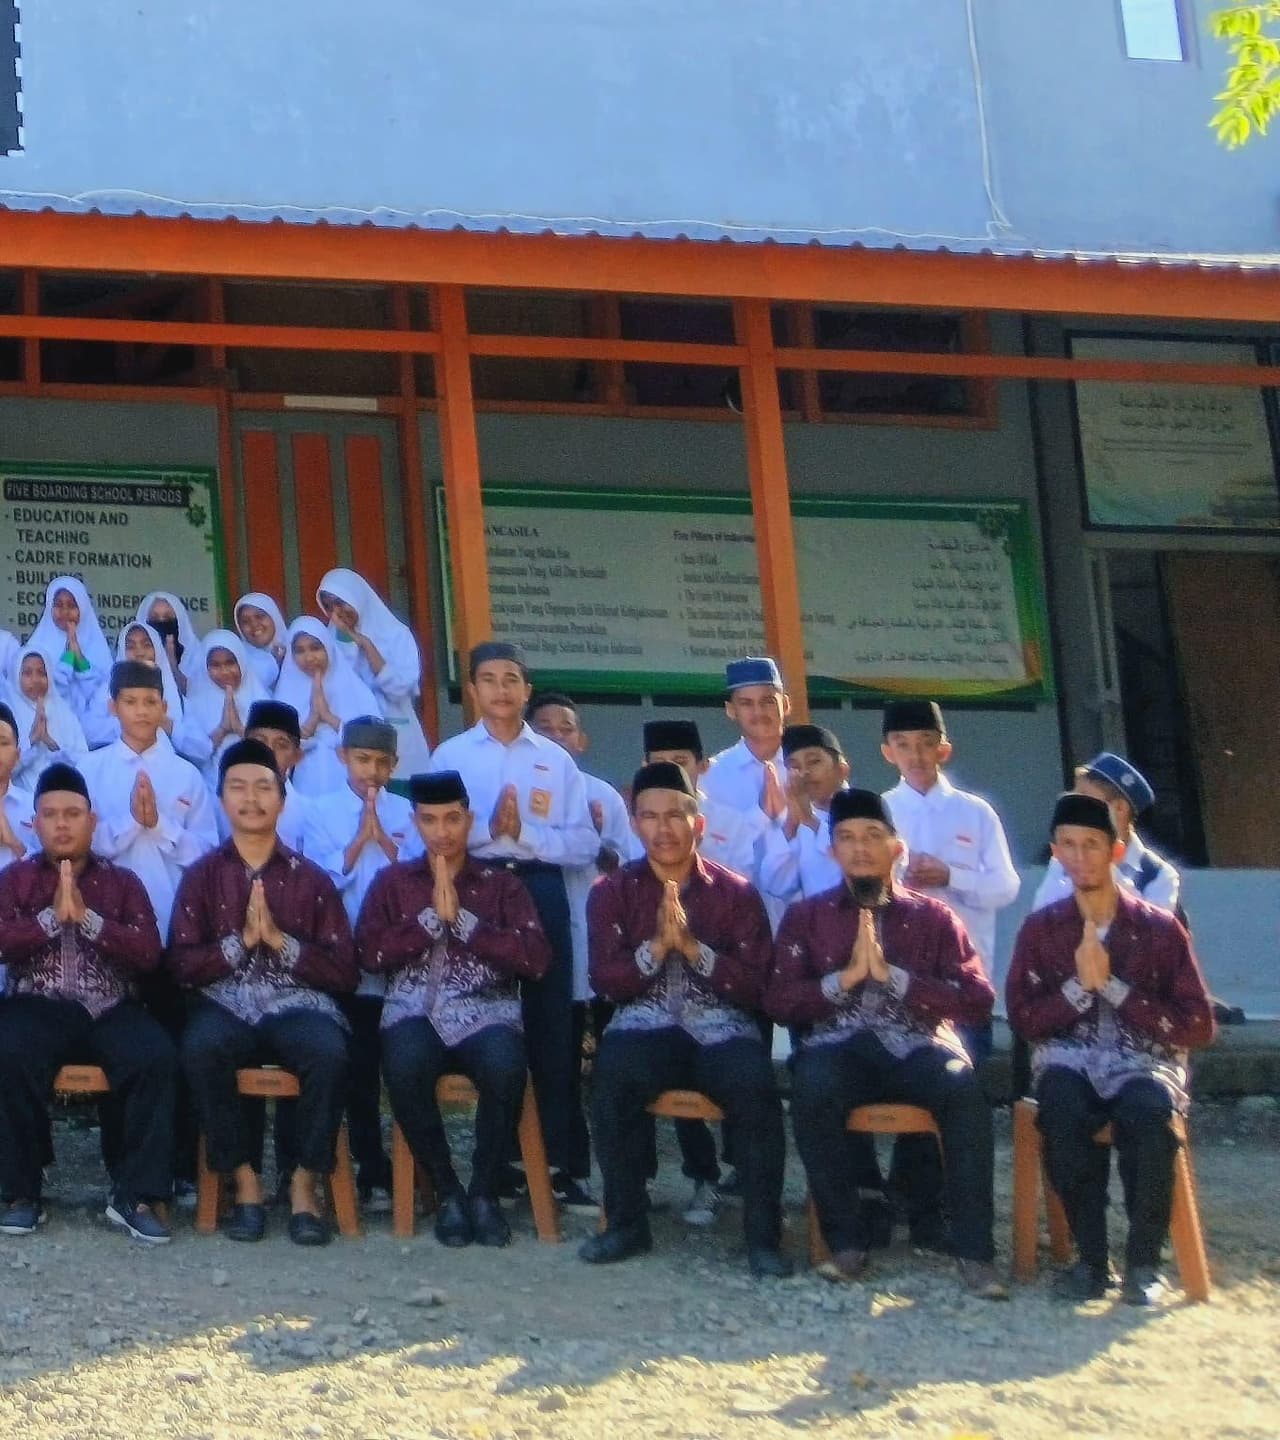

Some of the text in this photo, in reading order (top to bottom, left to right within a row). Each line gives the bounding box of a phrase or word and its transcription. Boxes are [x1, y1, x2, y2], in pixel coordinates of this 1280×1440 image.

[6, 483, 183, 503] FIVE BOARDING SCHOOL PERIODS
[13, 508, 129, 526] EDUCATION AND
[17, 529, 90, 545] TEACHING
[485, 526, 540, 538] ANCASILA
[15, 550, 152, 569] CADRE FORMATION
